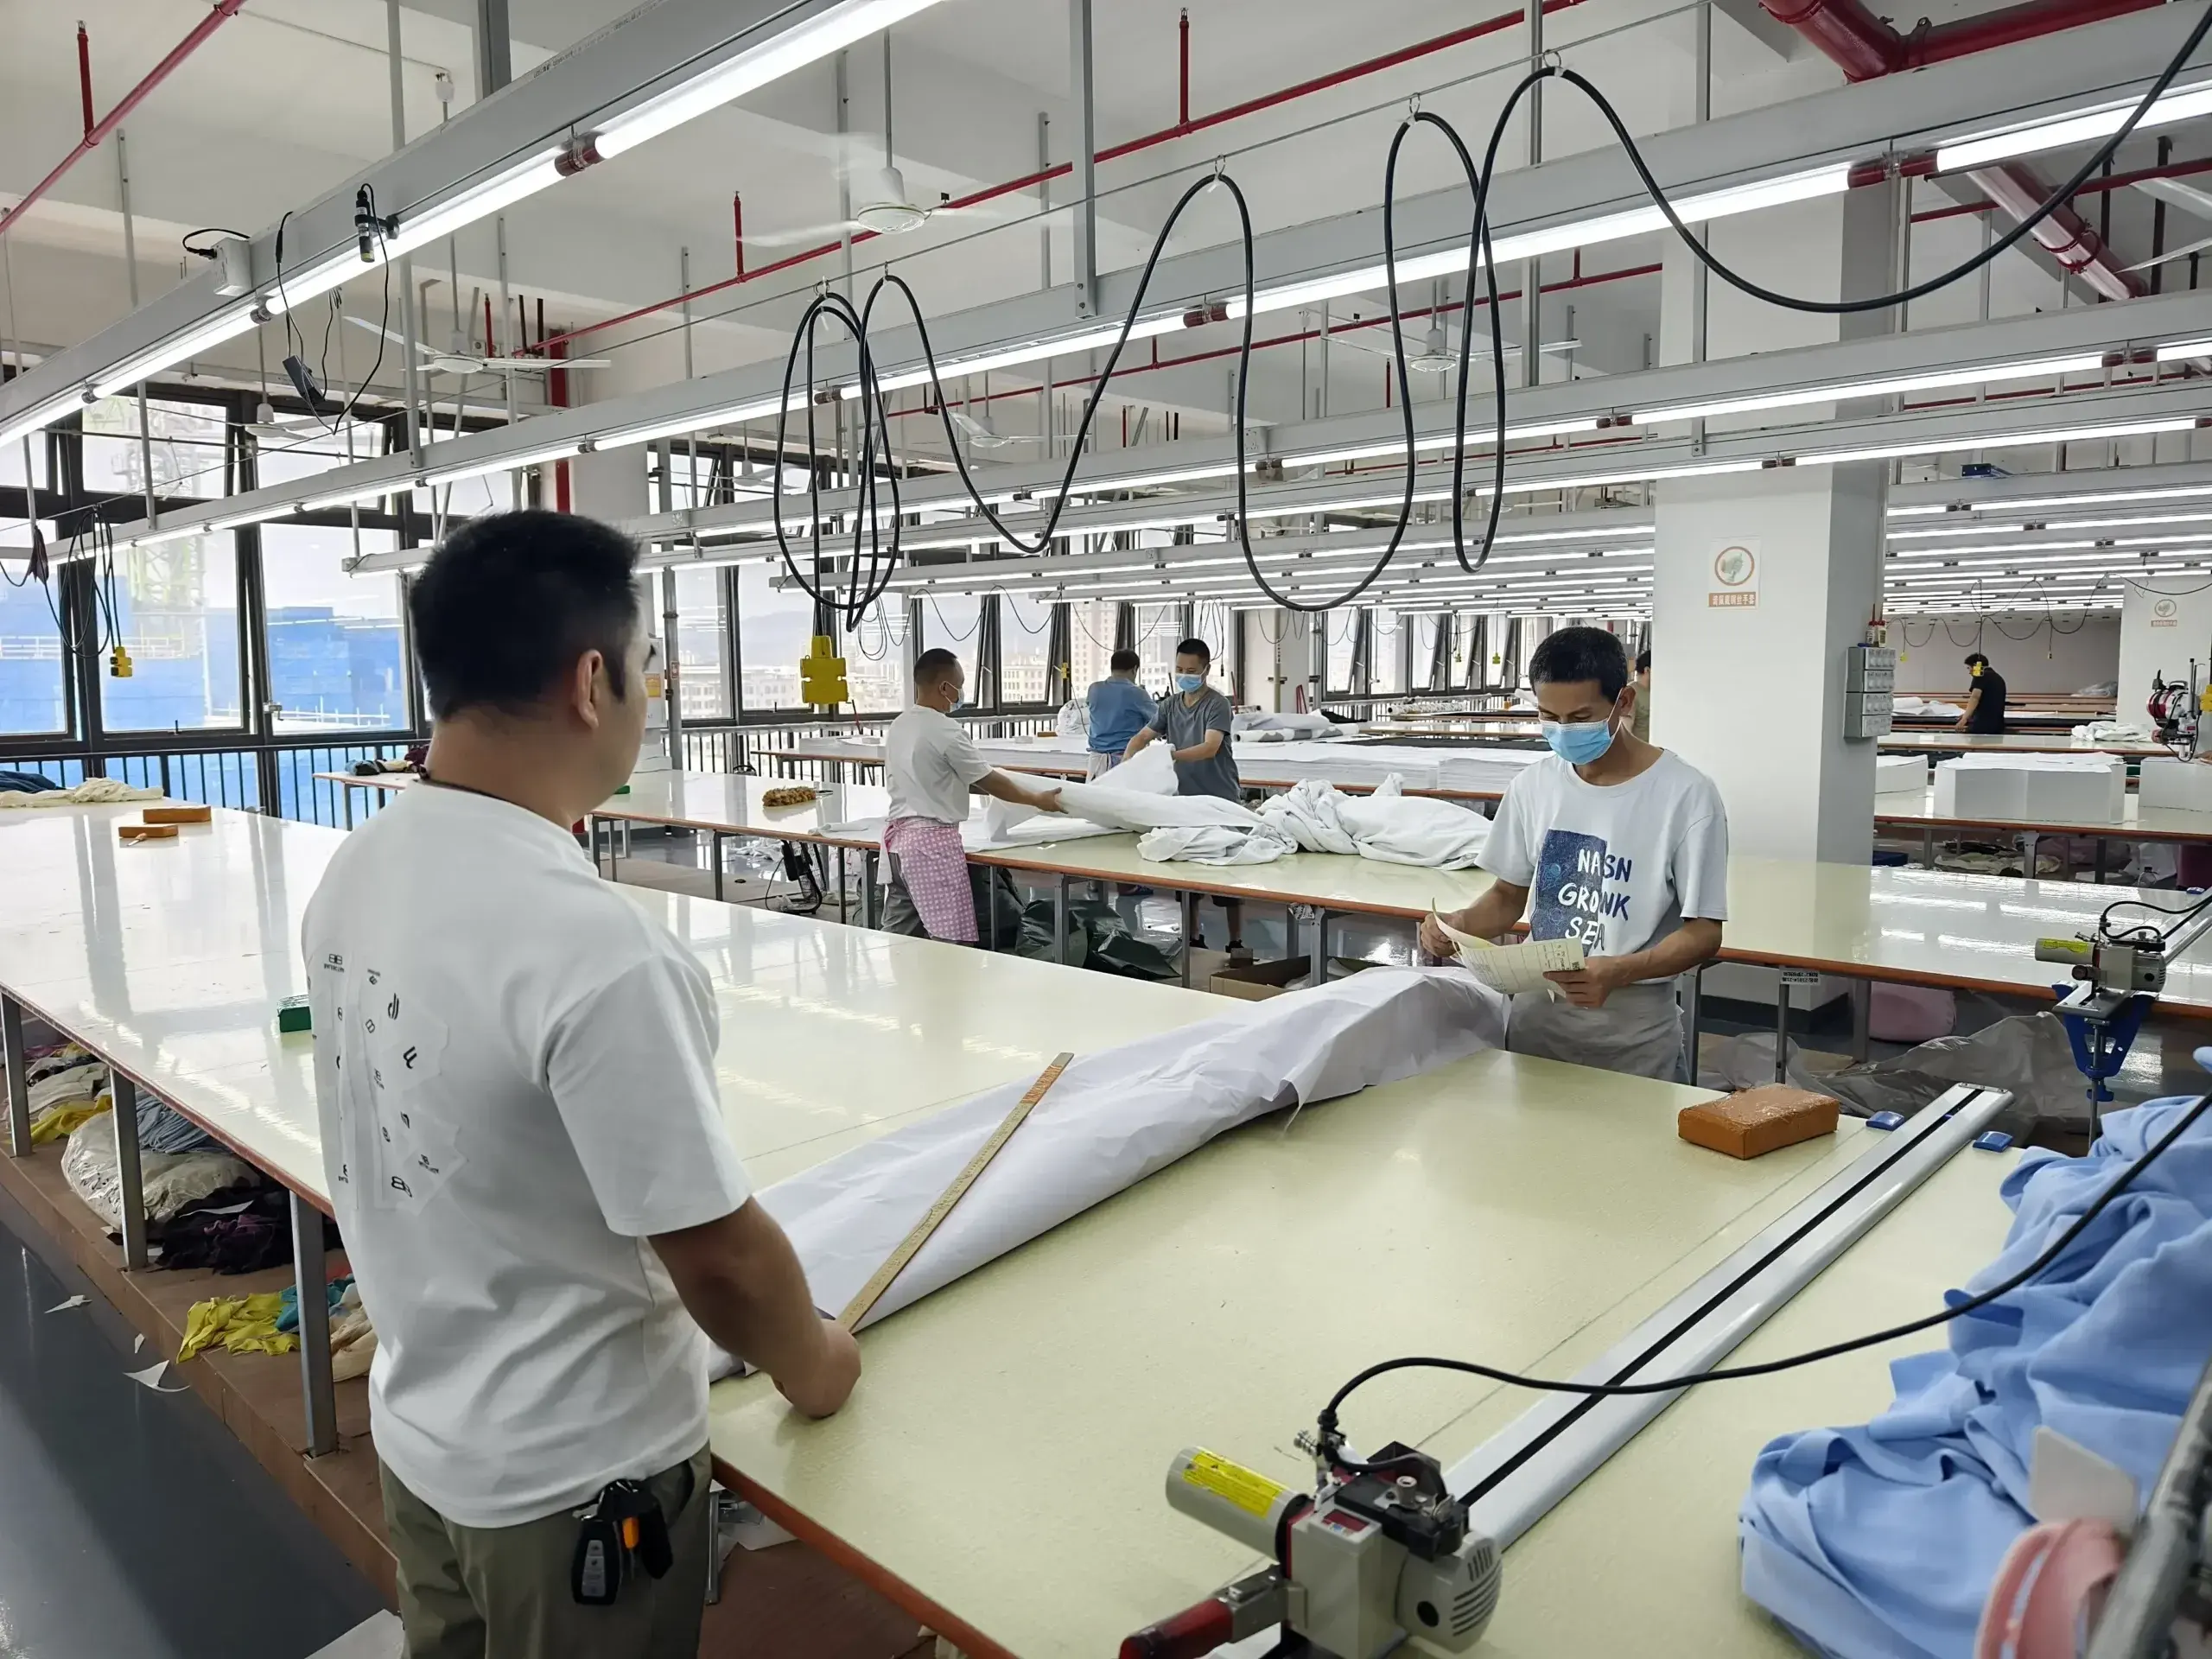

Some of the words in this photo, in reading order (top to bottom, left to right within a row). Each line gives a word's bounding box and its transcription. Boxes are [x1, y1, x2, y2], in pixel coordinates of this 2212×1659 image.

[1577, 849, 1632, 882] NASN
[1558, 882, 1630, 921] GRONK
[1565, 917, 1605, 950] SEA
